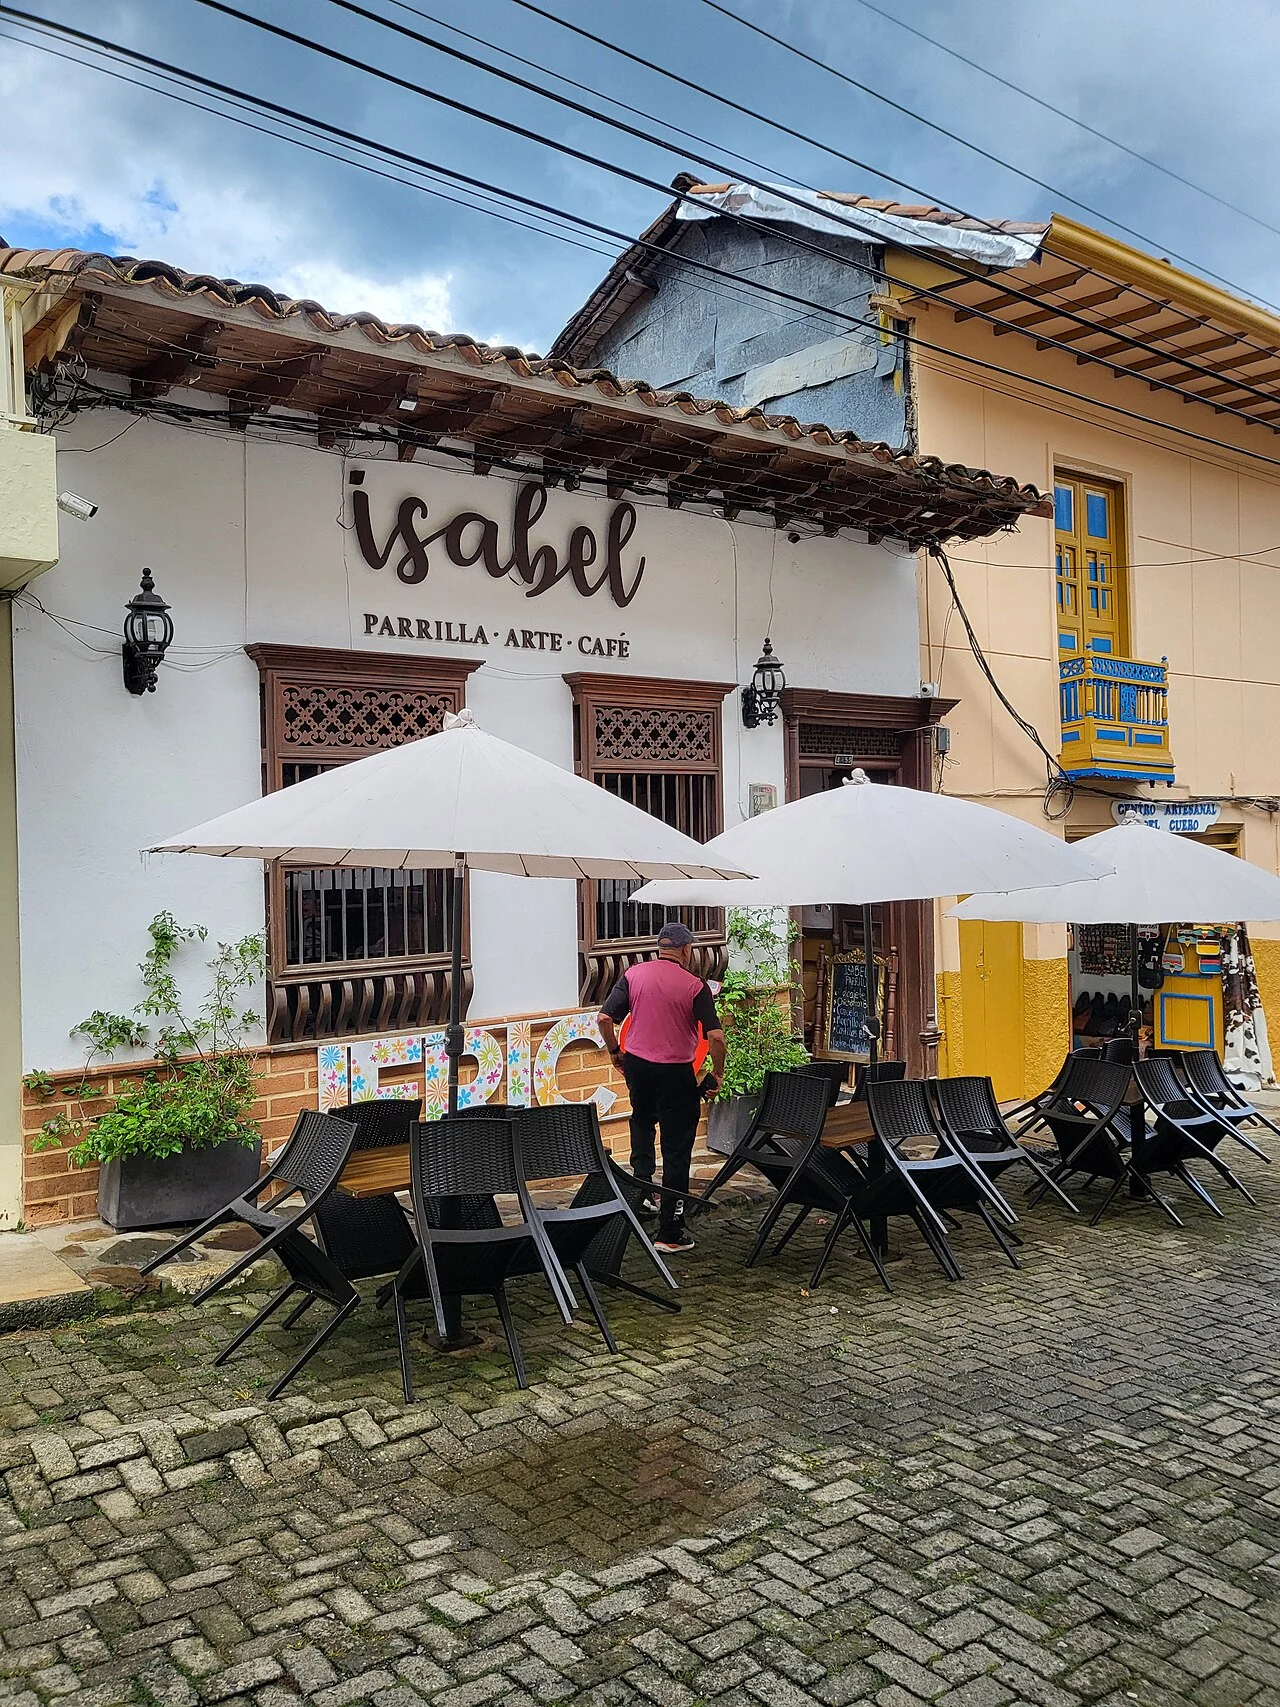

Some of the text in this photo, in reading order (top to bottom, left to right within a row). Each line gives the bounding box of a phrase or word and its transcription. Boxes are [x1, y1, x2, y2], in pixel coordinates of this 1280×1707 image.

[349, 470, 646, 608] isabel
[363, 613, 630, 658] PARRILLA ARTE CAFÉ
[1117, 802, 1217, 816] CENTRO ARTESANAL
[1168, 820, 1199, 831] CUERO
